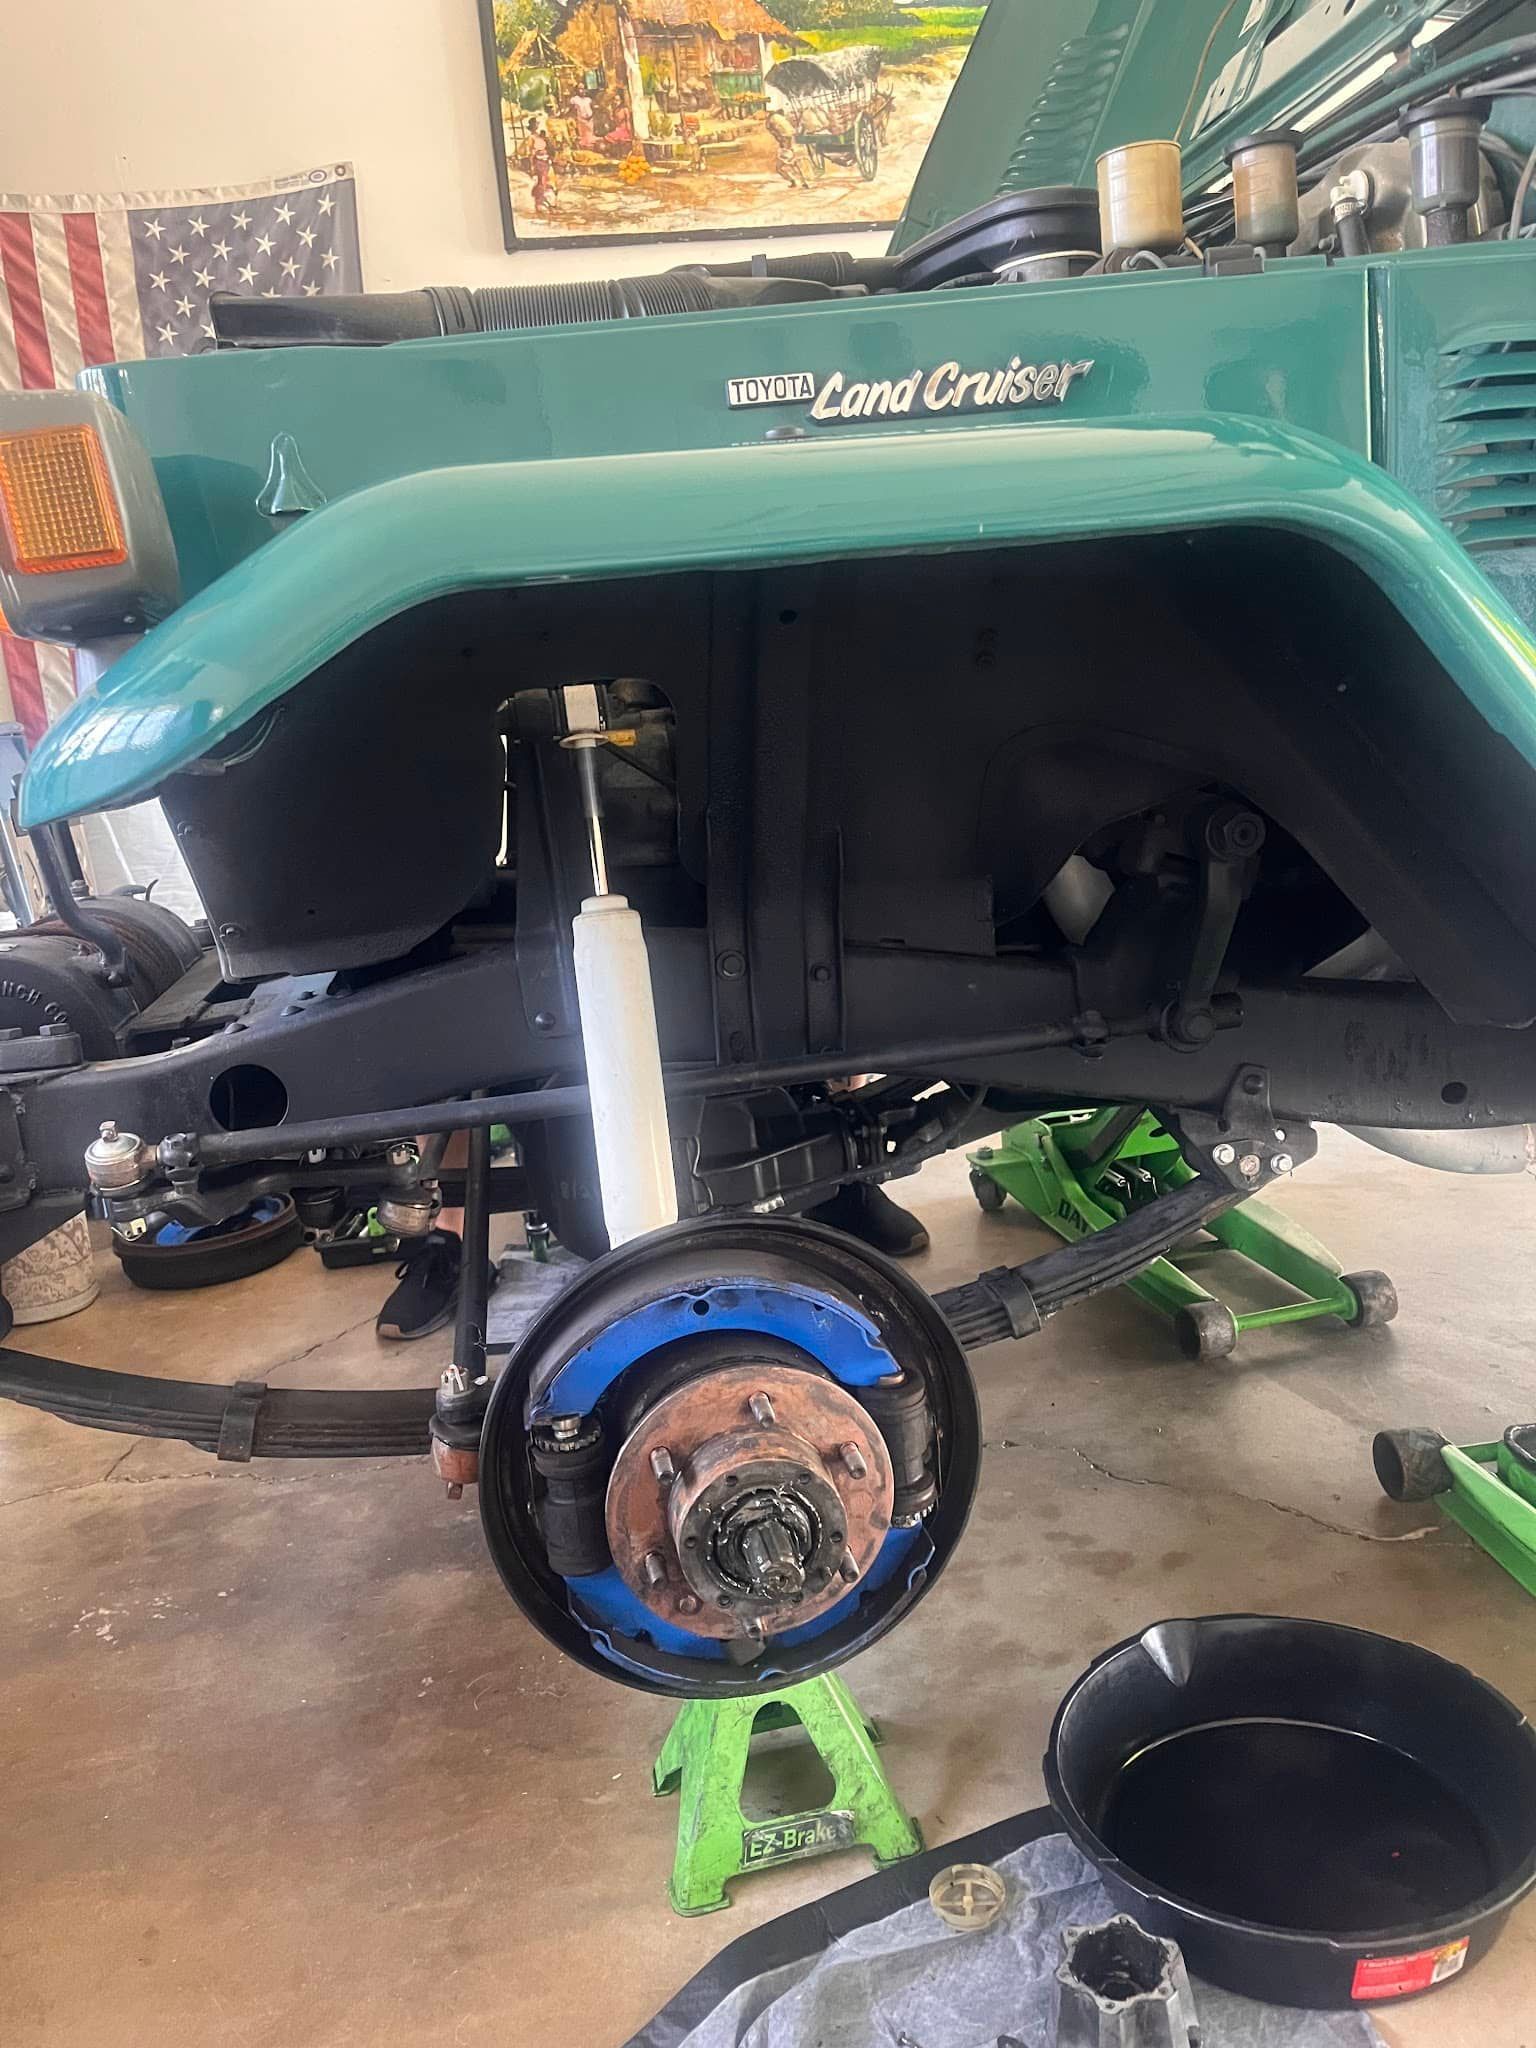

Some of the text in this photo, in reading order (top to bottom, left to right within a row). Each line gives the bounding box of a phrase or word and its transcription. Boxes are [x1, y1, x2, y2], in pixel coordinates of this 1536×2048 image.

[731, 356, 1095, 420] TOYOTA Land Cruiser
